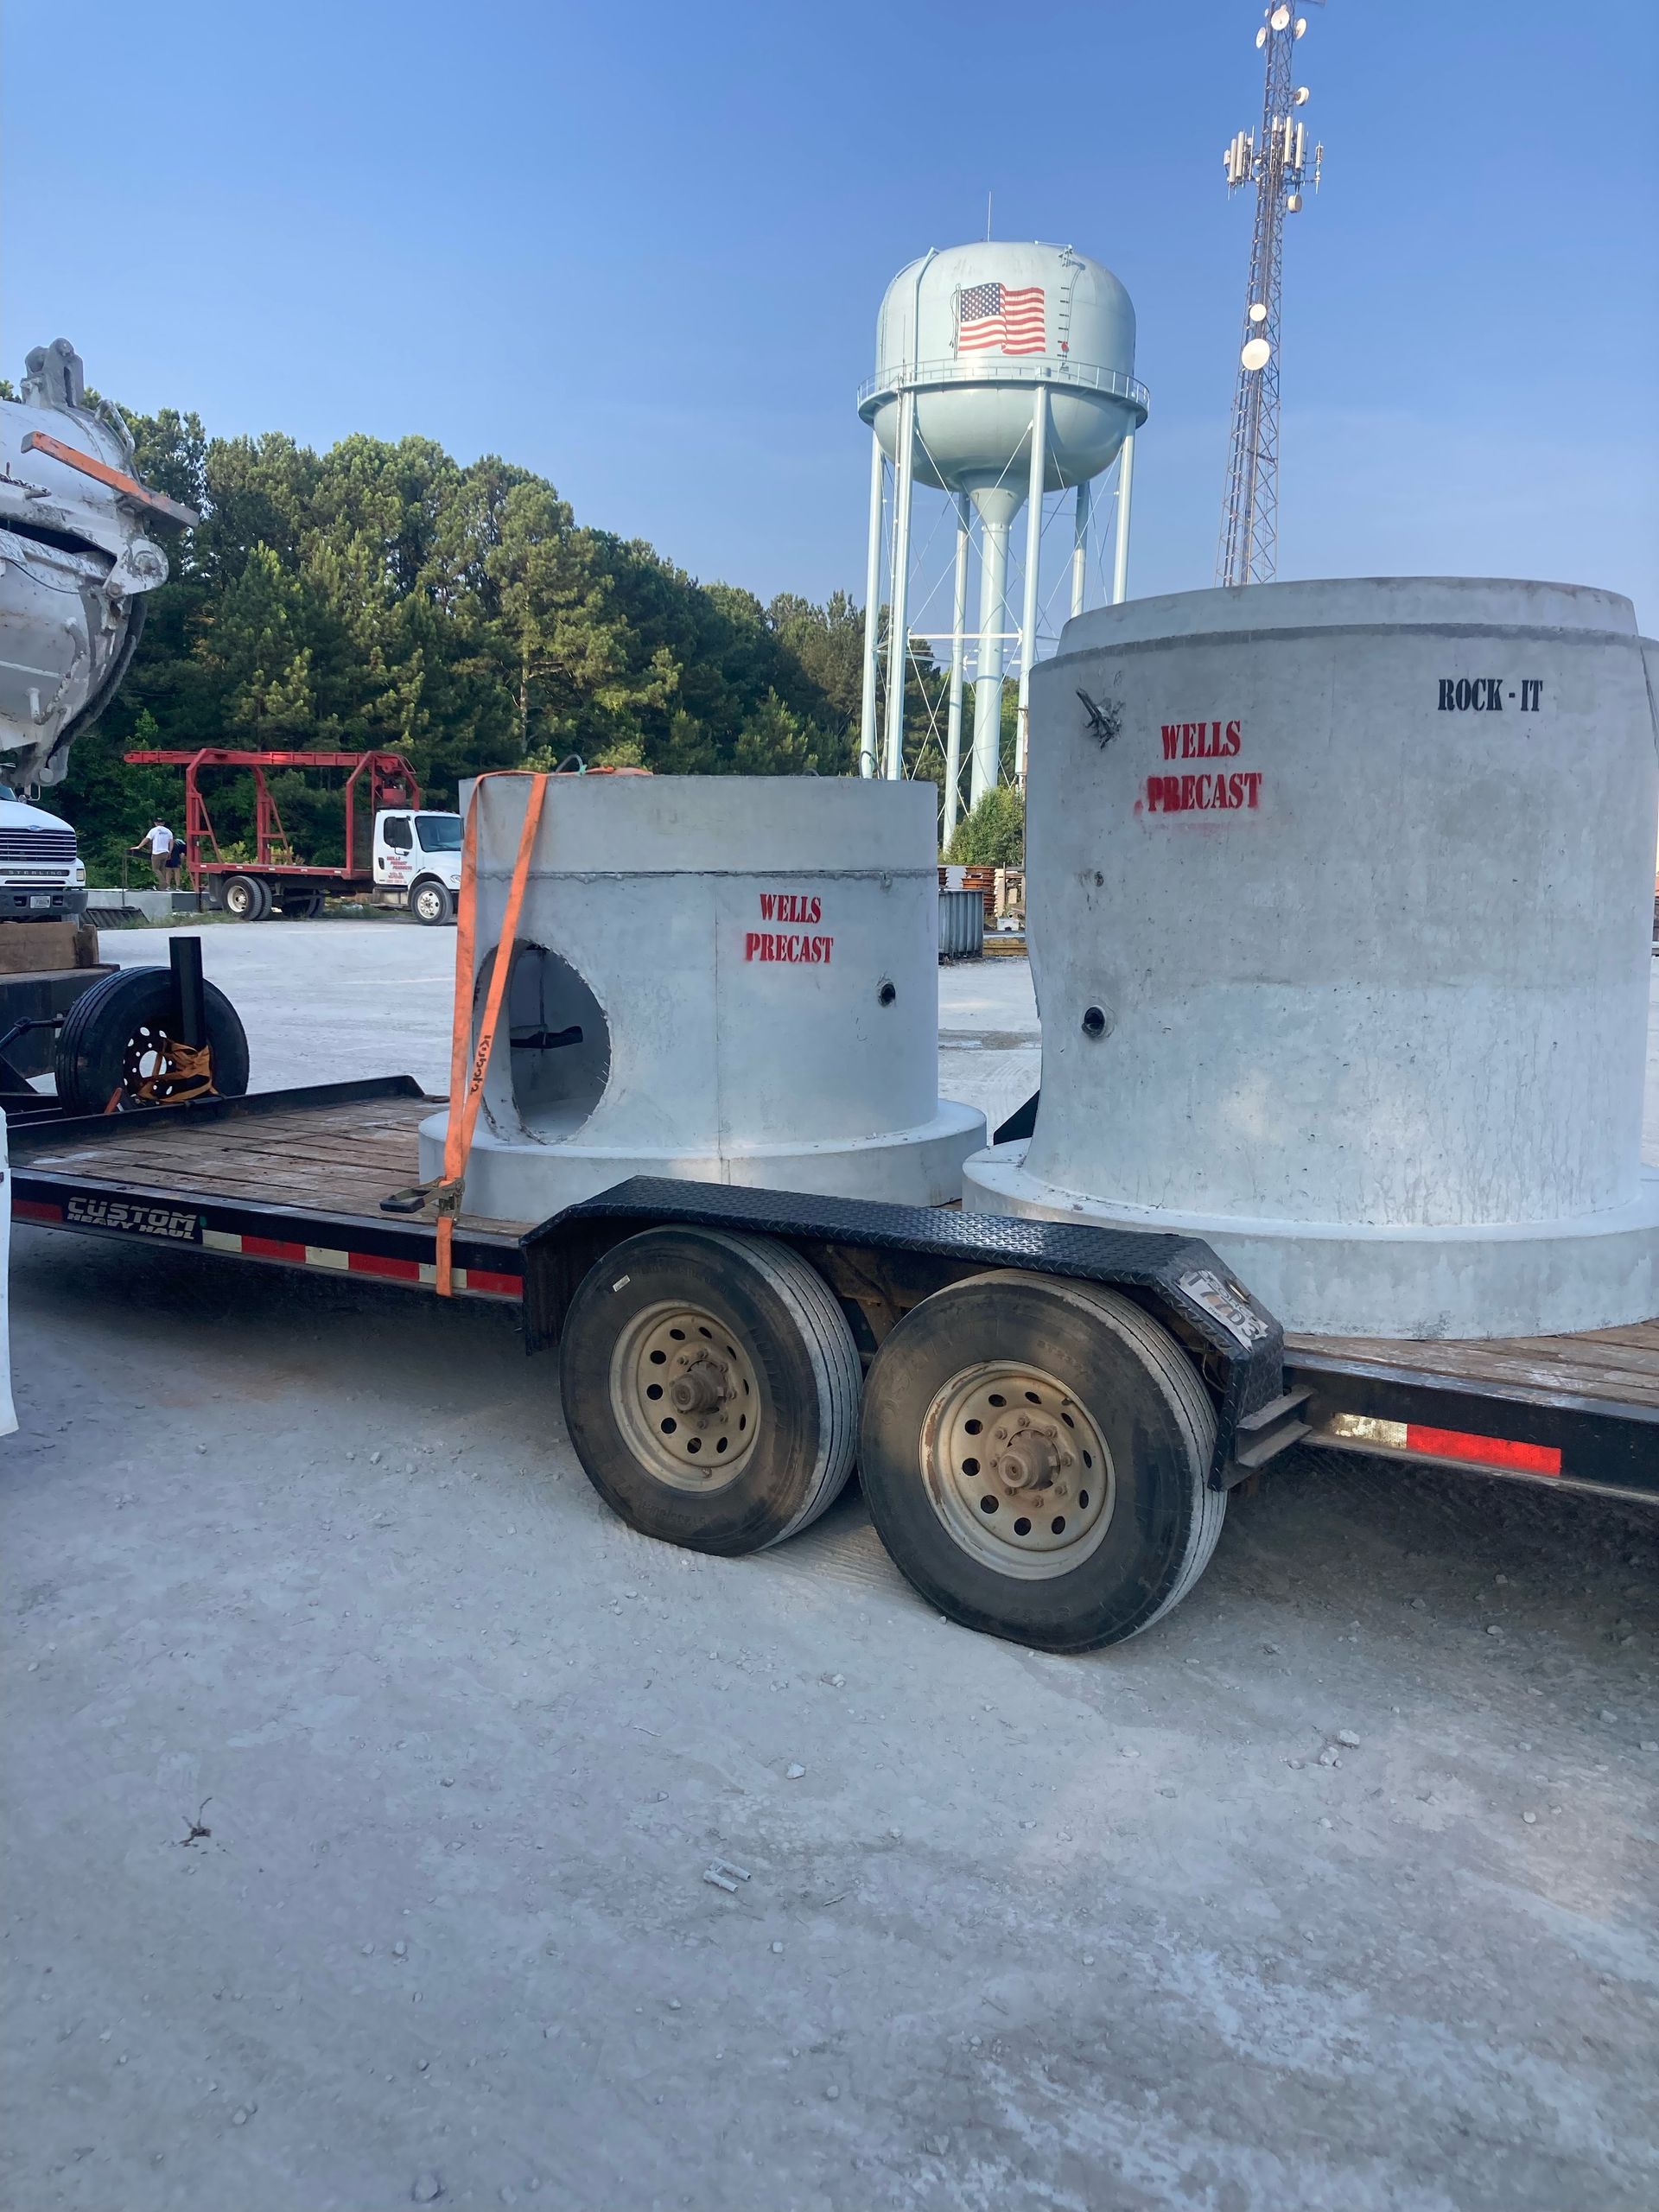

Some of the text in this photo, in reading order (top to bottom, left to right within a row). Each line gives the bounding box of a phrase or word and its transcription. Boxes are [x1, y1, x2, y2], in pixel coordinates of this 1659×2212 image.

[1160, 721, 1241, 760] WELLS
[1147, 772, 1262, 812] PRECAST
[760, 893, 821, 924] WELLS
[746, 932, 834, 963] PRECAST
[67, 1197, 197, 1232] CUSTOM
[67, 1212, 194, 1240] HEAVY HAUL
